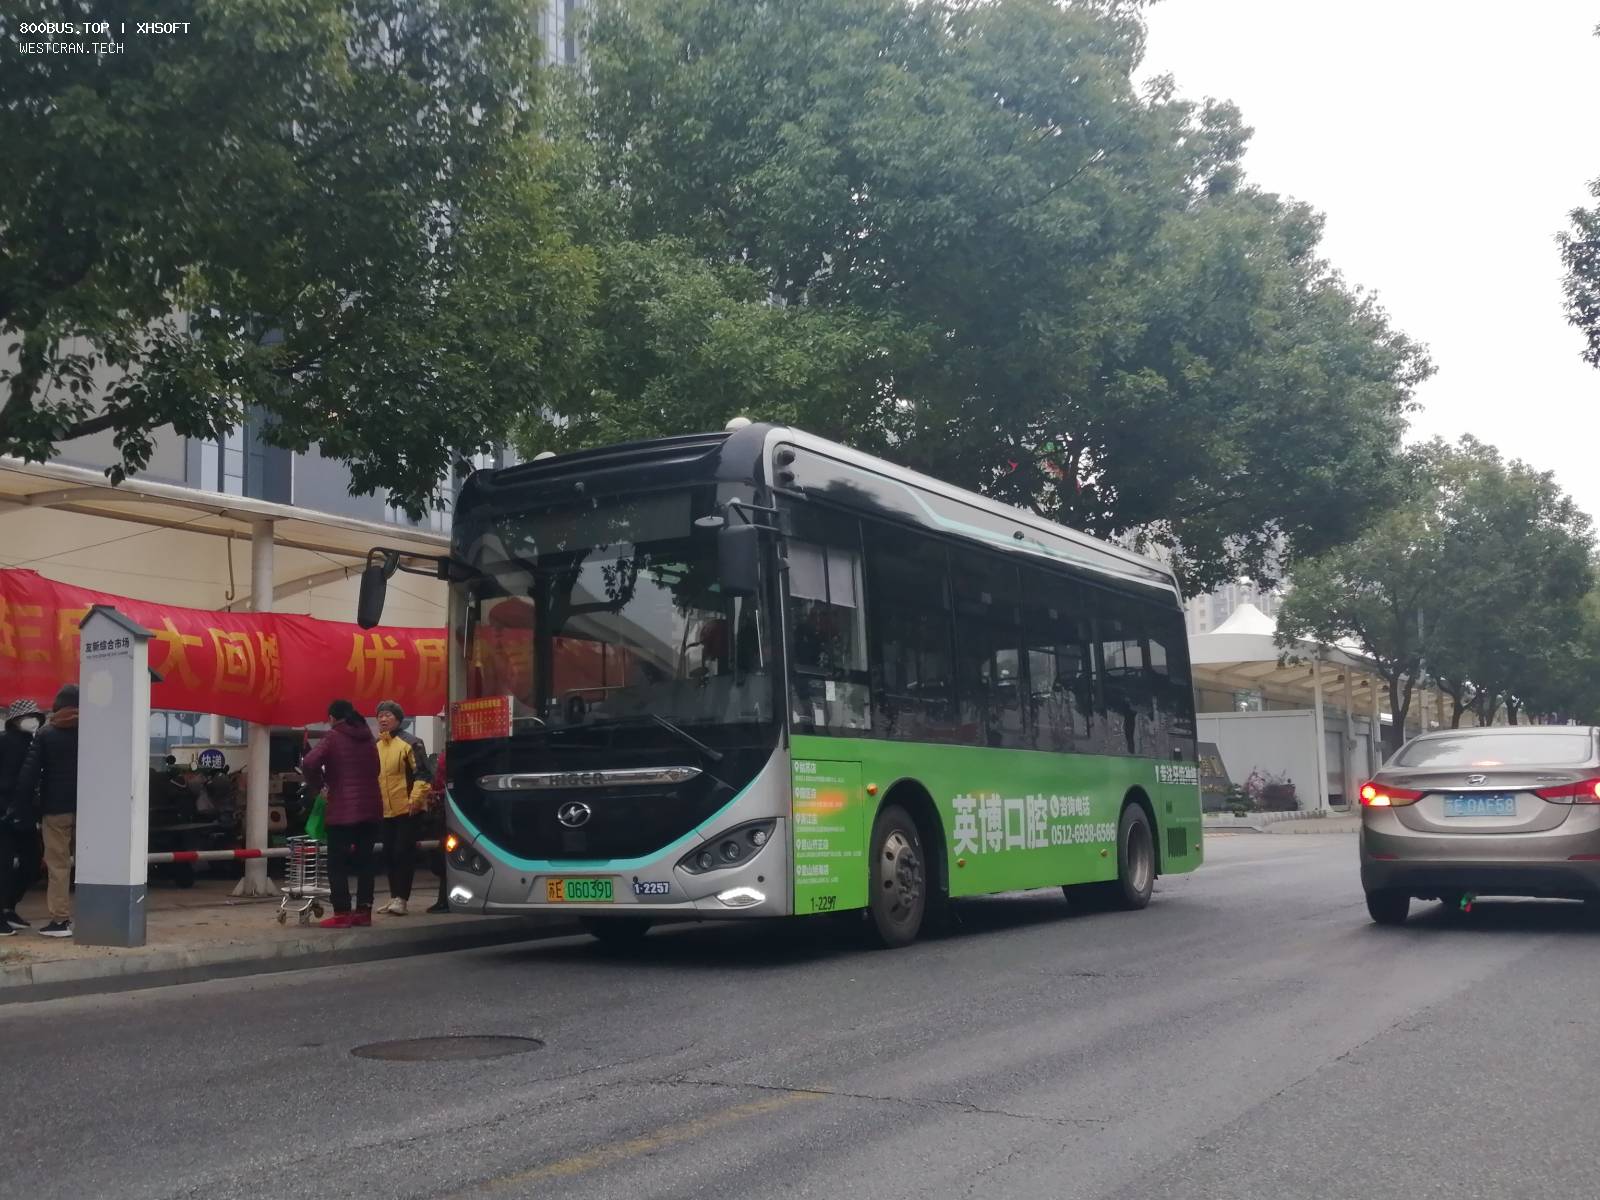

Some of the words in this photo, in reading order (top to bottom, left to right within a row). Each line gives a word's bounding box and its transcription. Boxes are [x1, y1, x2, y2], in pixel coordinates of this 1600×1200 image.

[201, 753, 222, 769] 快递
[952, 793, 1049, 856] 英博口腔
